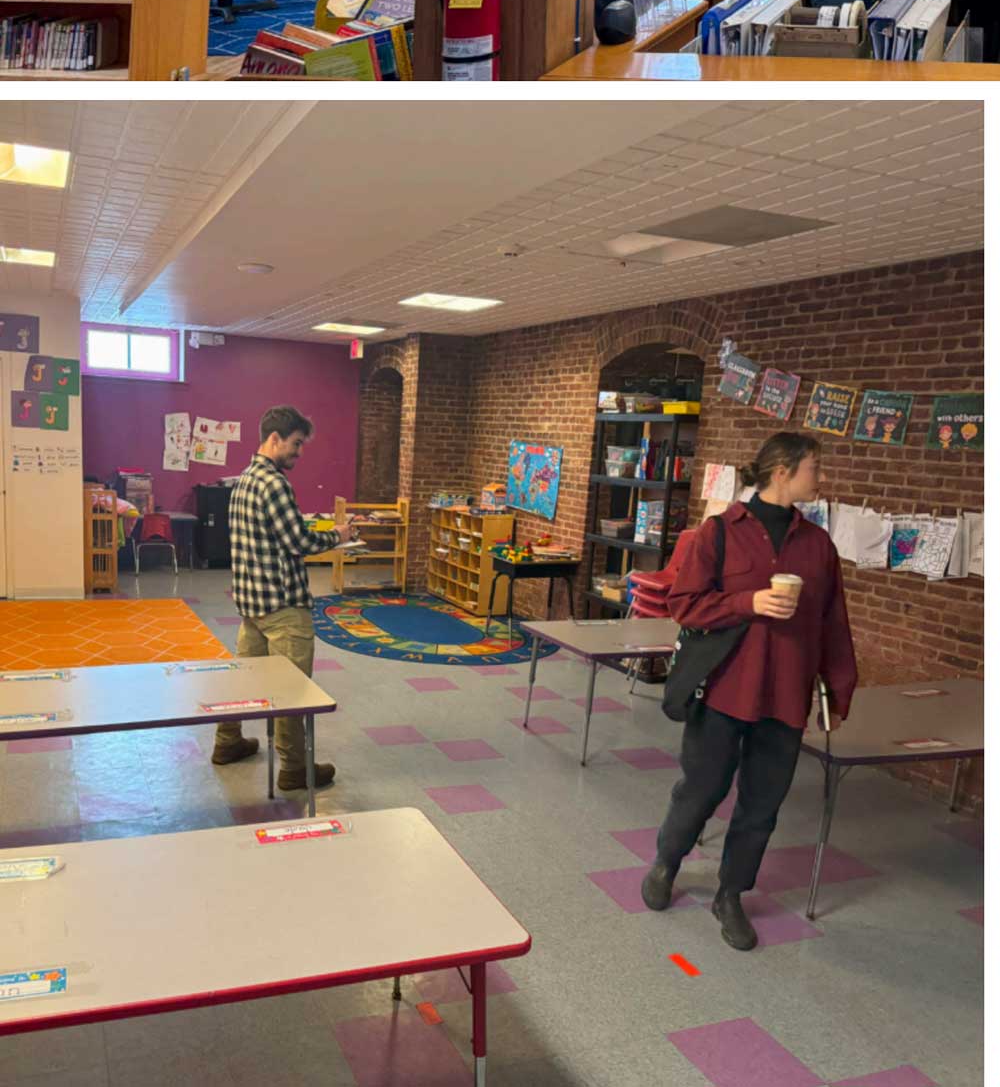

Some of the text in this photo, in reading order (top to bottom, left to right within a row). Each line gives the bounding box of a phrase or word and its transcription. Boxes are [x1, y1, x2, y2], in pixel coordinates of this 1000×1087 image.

[376, 0, 415, 13] TWO LE
[953, 413, 984, 423] others
